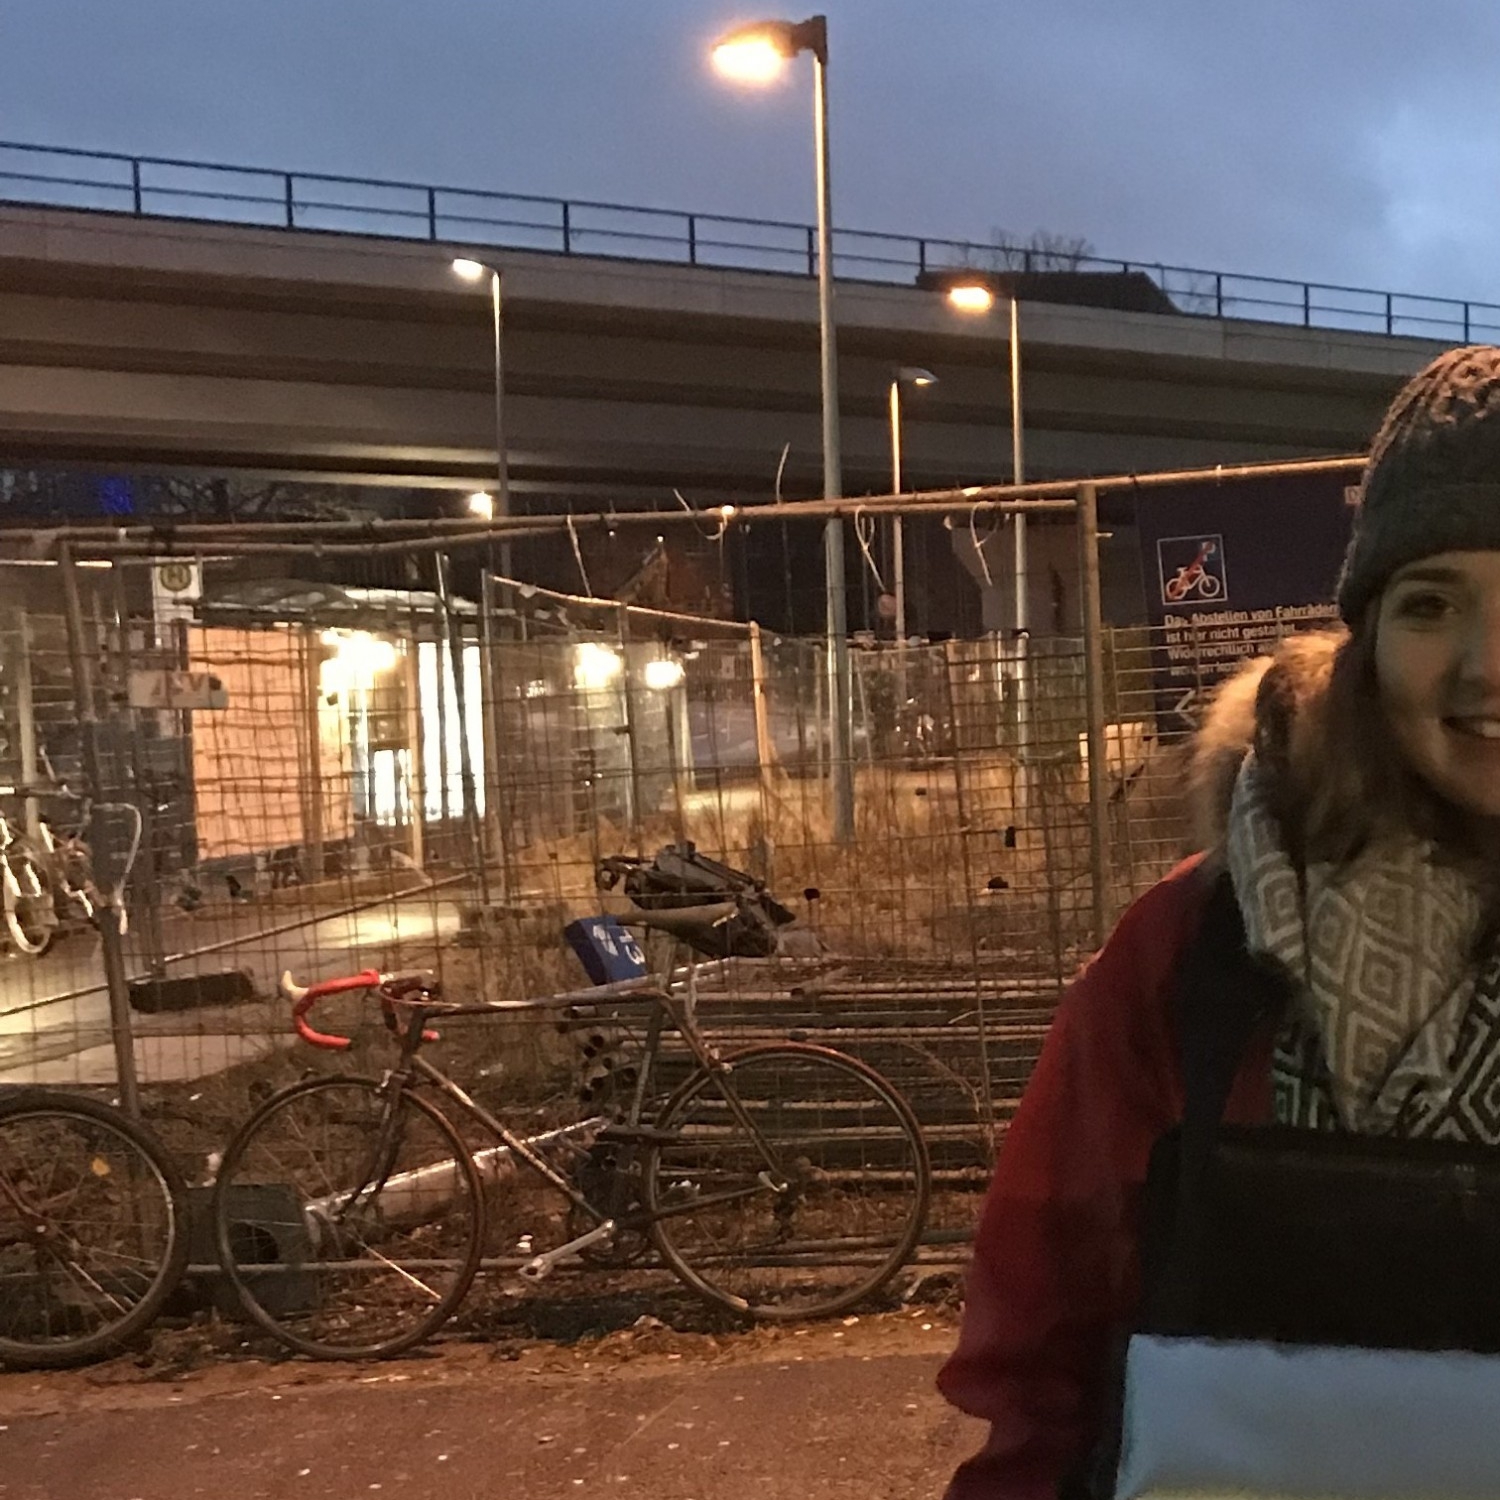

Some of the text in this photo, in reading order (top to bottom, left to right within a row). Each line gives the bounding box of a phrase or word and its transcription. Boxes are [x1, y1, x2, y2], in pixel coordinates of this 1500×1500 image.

[1192, 610, 1248, 626] Abstellen
[1251, 608, 1273, 621] von
[1166, 630, 1180, 643] ist
[1184, 630, 1206, 642] her
[1209, 627, 1240, 640] nicht
